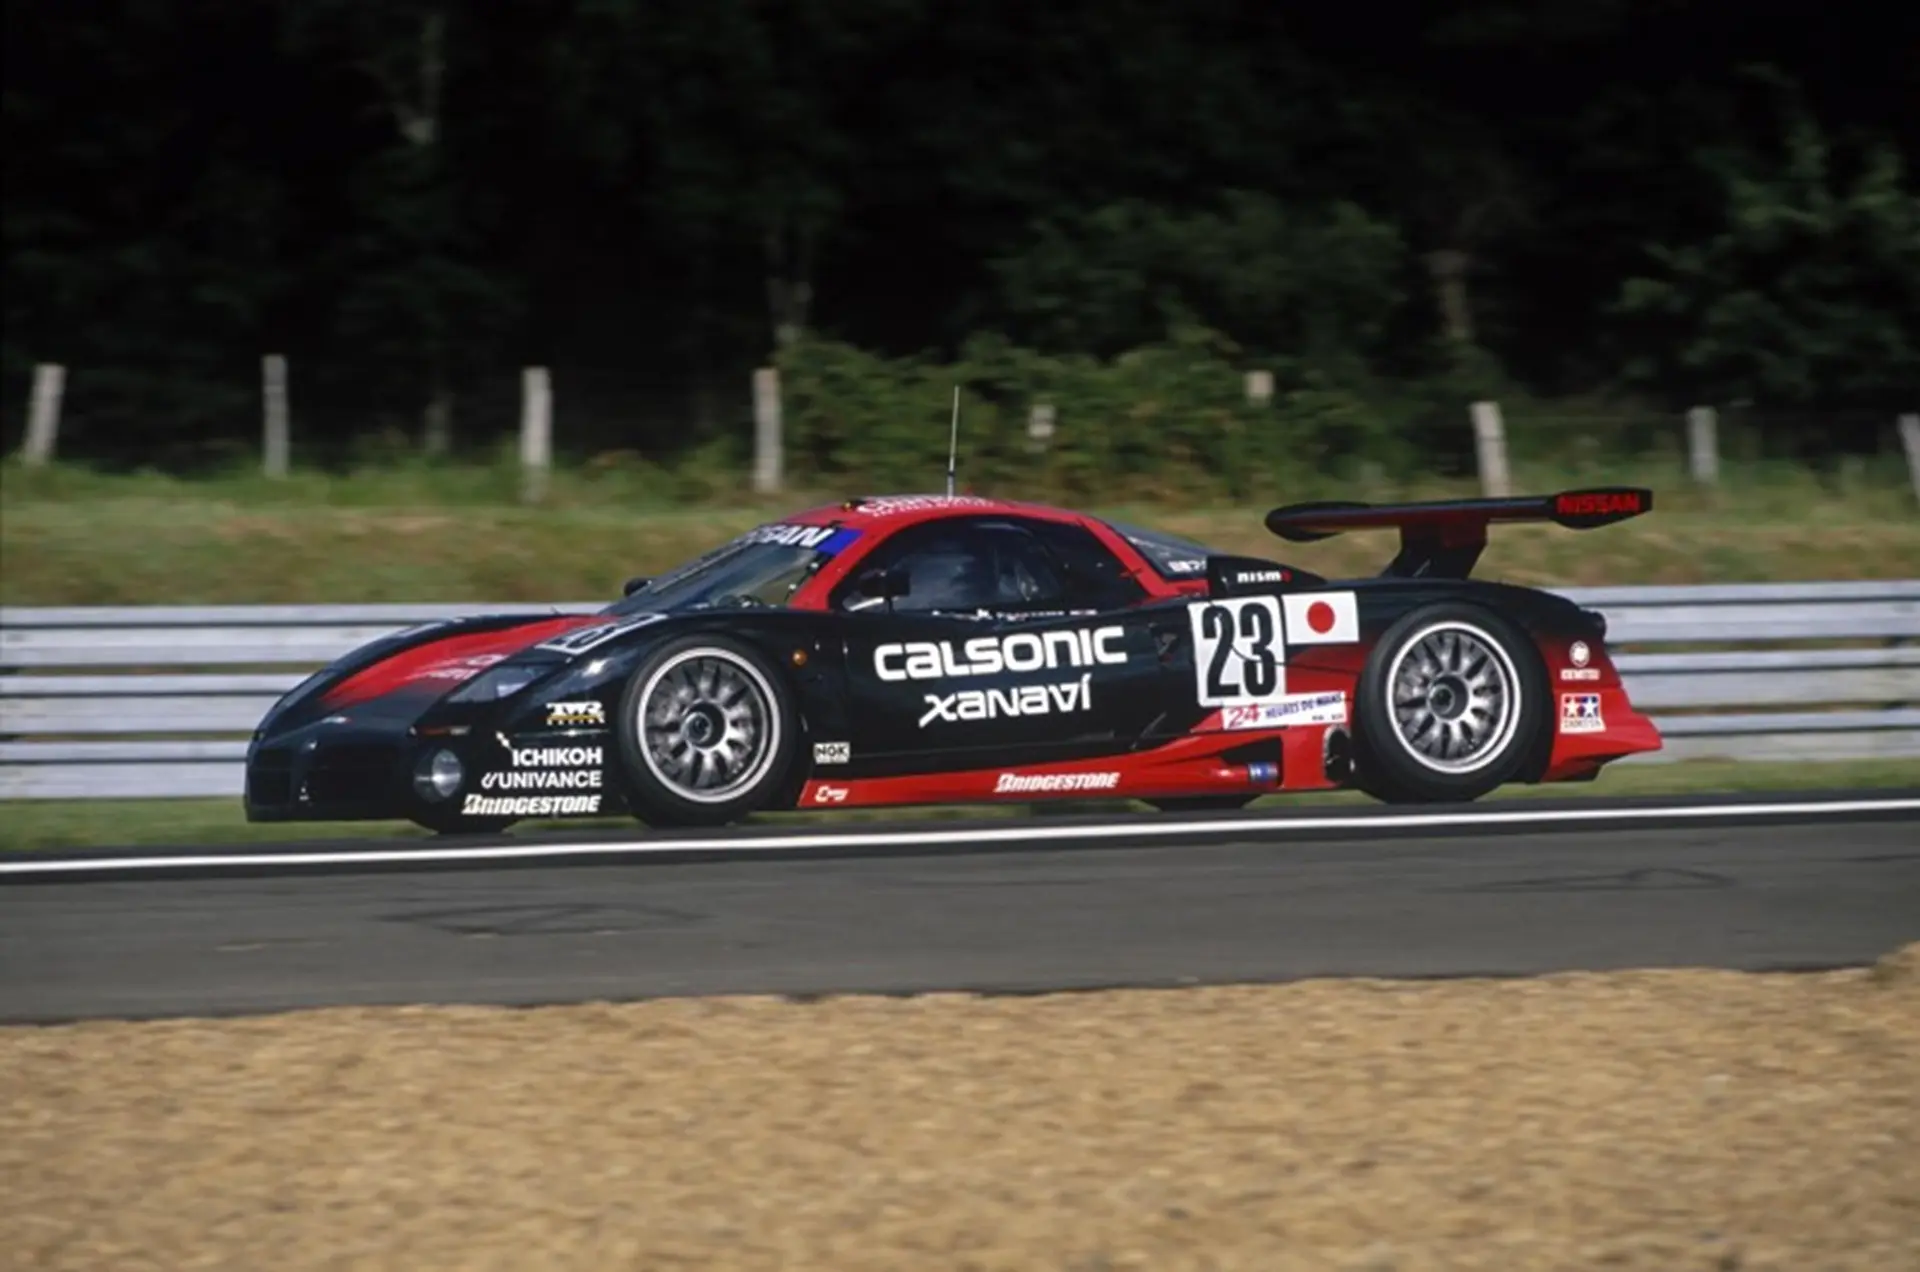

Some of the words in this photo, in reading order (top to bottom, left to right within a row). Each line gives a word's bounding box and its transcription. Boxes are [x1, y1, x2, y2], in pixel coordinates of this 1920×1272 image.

[1558, 493, 1639, 514] NISSAN
[1201, 601, 1277, 699] 23
[1228, 703, 1261, 729] 24
[512, 747, 603, 767] ICHIKOH
[993, 772, 1121, 794] BRIDGESTONE
[461, 793, 602, 815] BRIDGESTONE
